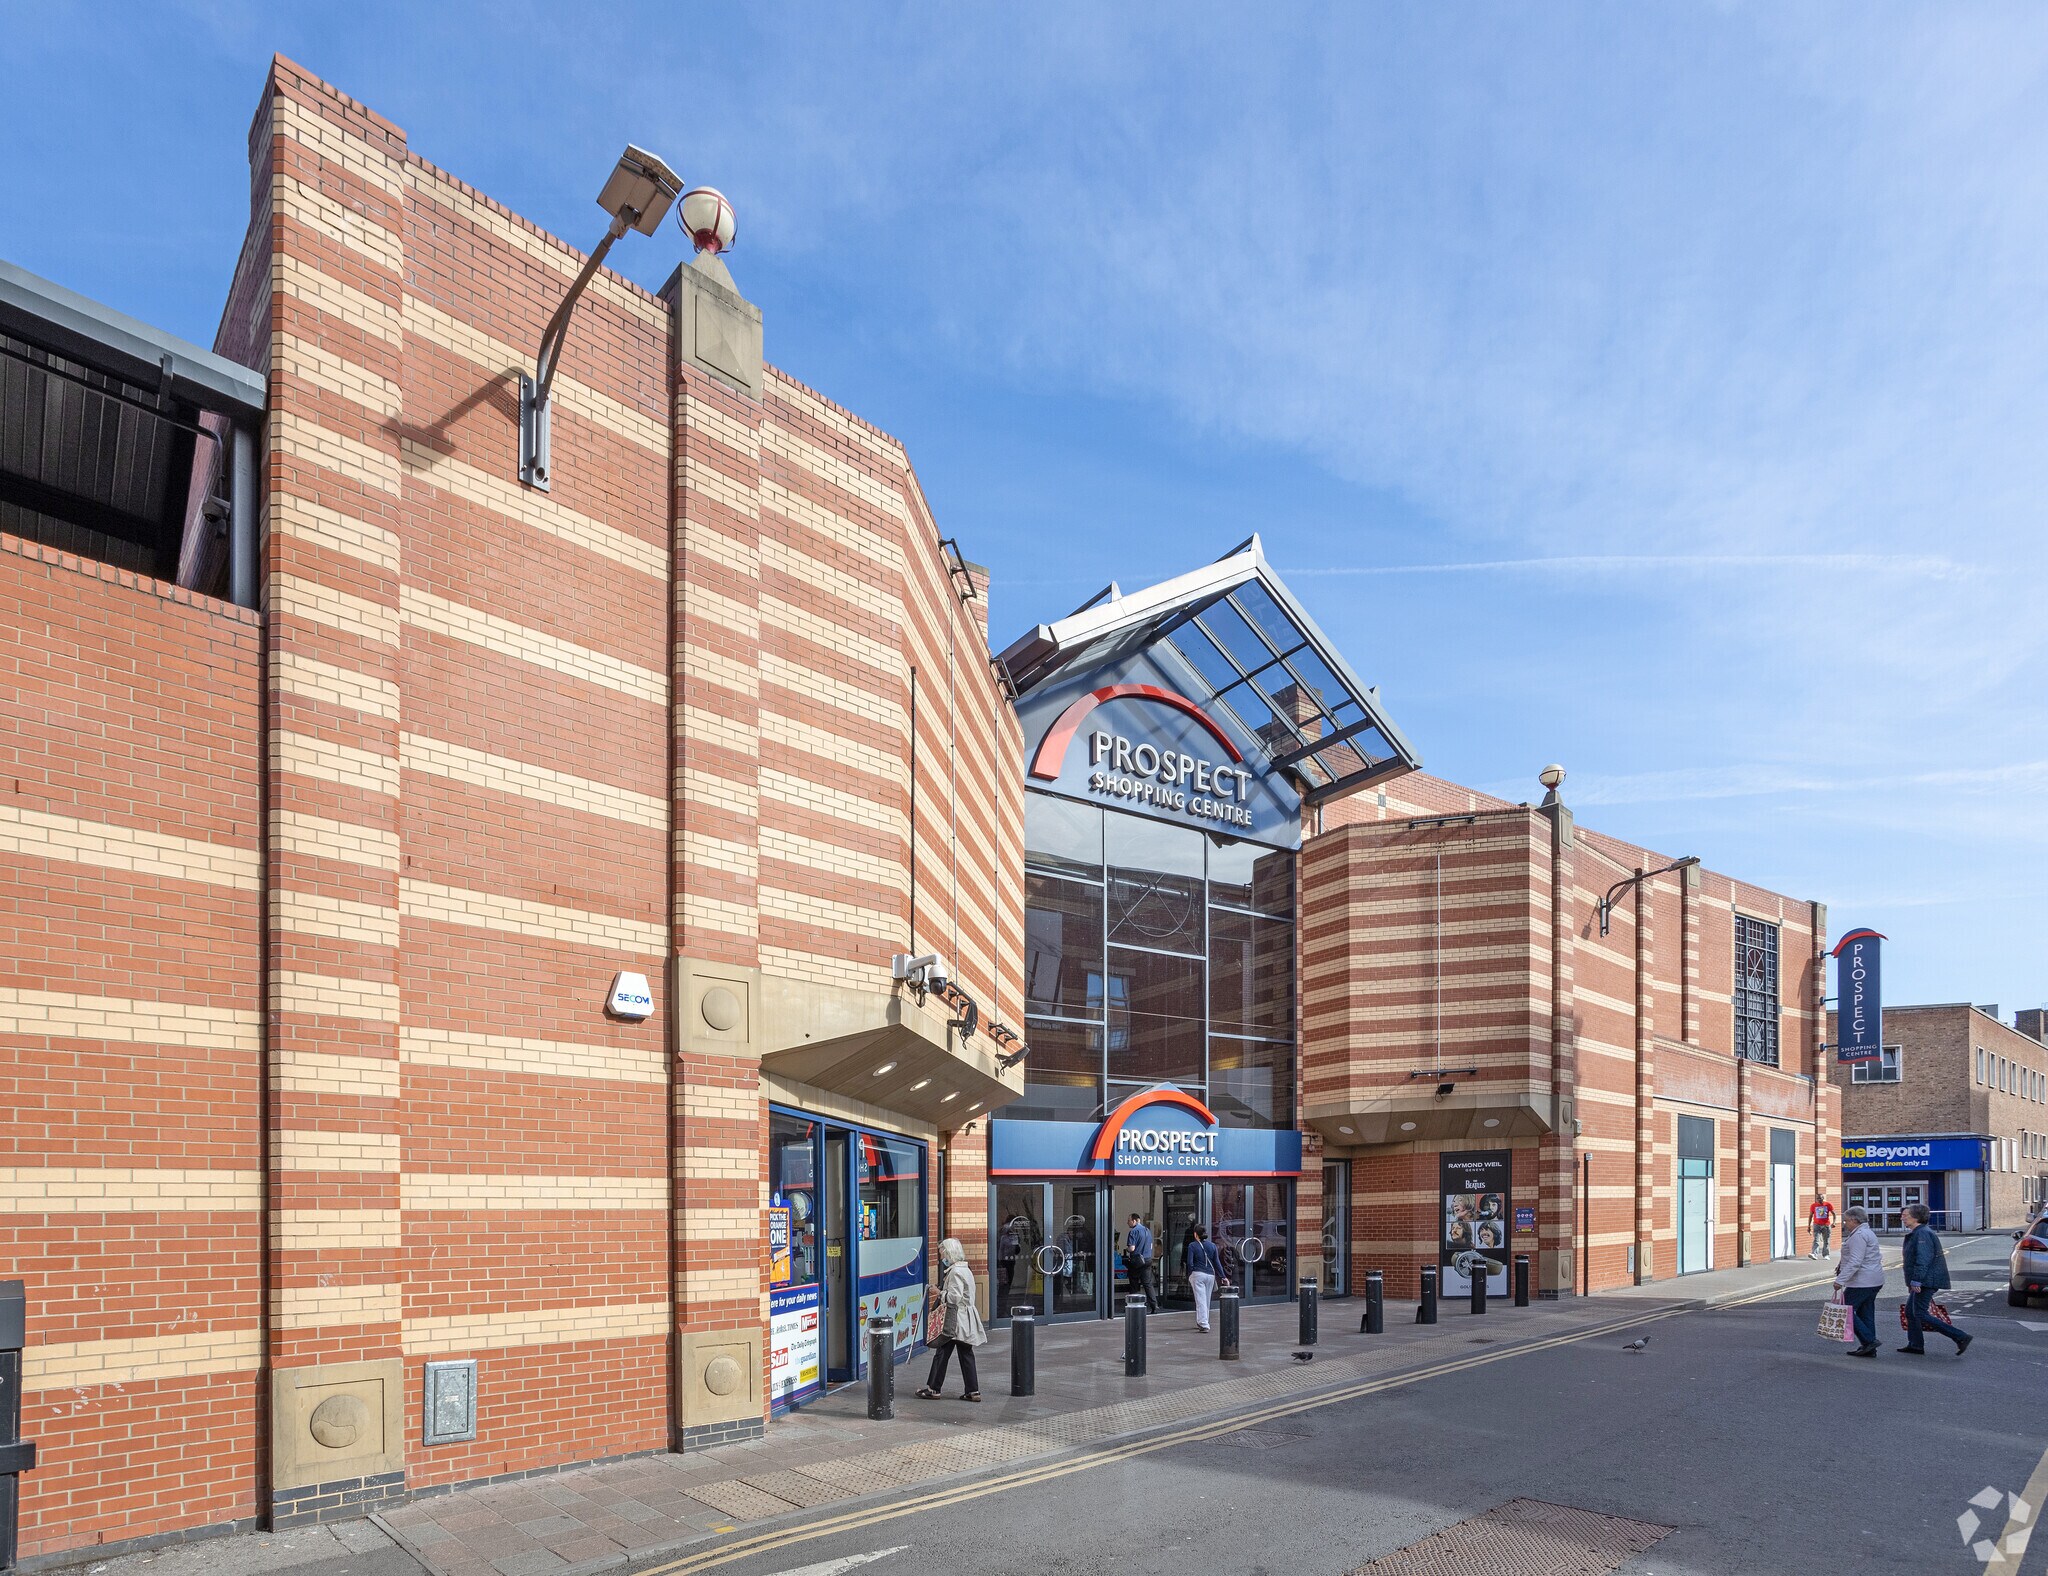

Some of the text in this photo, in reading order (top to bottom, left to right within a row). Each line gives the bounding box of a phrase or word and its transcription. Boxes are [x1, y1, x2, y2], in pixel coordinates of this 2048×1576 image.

[1093, 731, 1253, 801] PROSPECT
[1093, 771, 1253, 826] SHOPPING CENTRE
[617, 992, 650, 1005] SECOM
[1851, 943, 1866, 1043] PROSPECT
[1840, 1044, 1877, 1053] SHOPPING
[1845, 1050, 1872, 1058] CENTRE
[1118, 1128, 1219, 1153] PROSPECT
[1118, 1154, 1216, 1167] SHOPPING CENTRE
[1865, 1160, 1885, 1168] value
[1904, 1160, 1920, 1168] only
[779, 1213, 787, 1221] THE
[770, 1230, 786, 1244] ONE
[786, 1296, 796, 1308] your
[796, 1293, 806, 1304] daily
[806, 1292, 817, 1301] news
[771, 1352, 788, 1368] Sun
